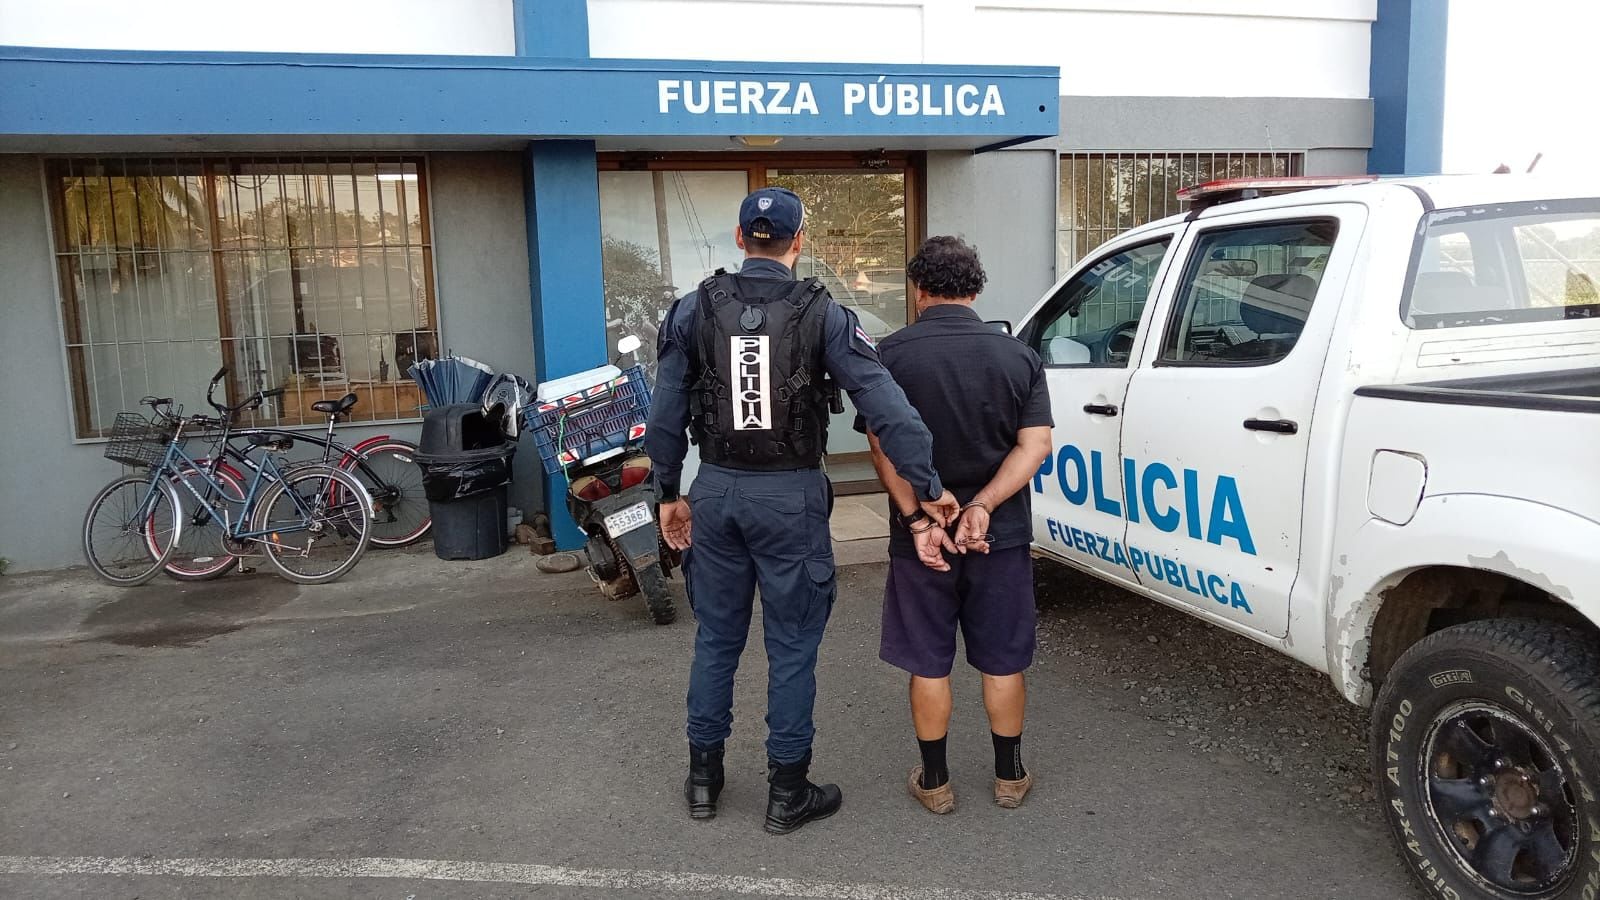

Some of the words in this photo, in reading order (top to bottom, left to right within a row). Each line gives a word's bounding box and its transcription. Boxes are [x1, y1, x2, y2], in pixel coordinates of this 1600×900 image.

[658, 79, 819, 114] FUERZA
[843, 75, 1006, 116] PÚBLICA
[740, 337, 762, 429] POLICIA
[1031, 444, 1258, 556] POLICIA
[1046, 518, 1131, 569] FUERZA
[1128, 545, 1254, 615] PUBLICA
[1387, 699, 1413, 787] AT100
